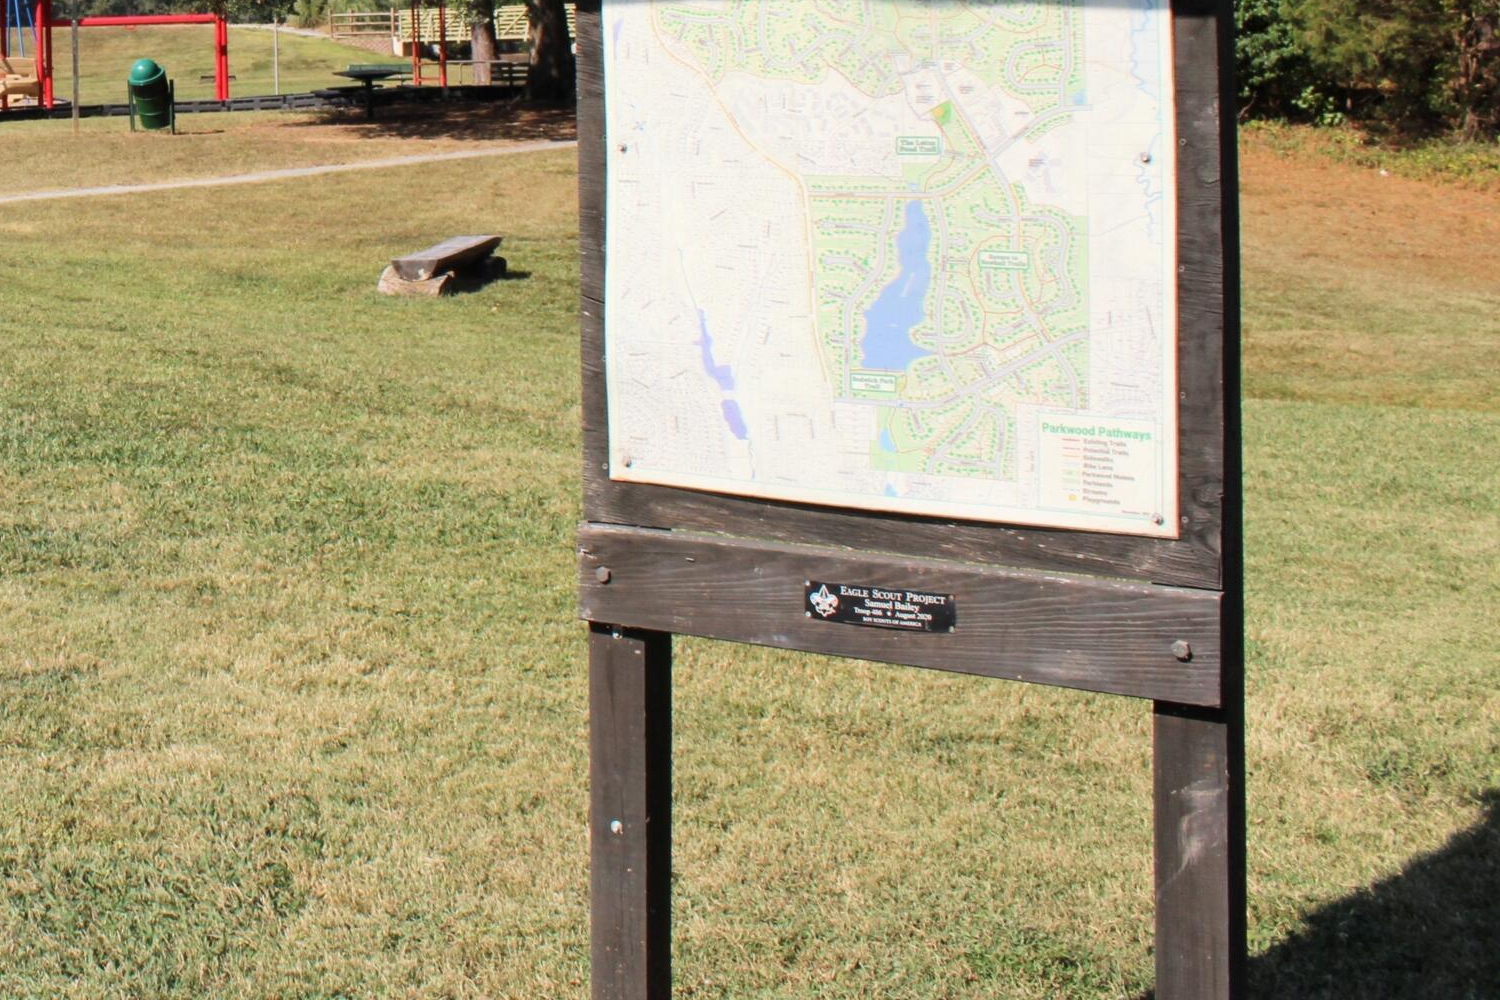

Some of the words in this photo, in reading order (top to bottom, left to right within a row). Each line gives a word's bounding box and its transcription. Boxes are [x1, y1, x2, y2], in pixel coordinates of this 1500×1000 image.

[1042, 422, 1095, 436] Parkwood
[1098, 426, 1152, 441] Pathways
[840, 586, 869, 598] EAGLE
[872, 589, 902, 601] SCOUT
[906, 592, 946, 605] PROJECT
[853, 607, 870, 615] Troop
[895, 612, 916, 620] August
[917, 613, 932, 621] 2020
[864, 599, 893, 609] Samuel
[895, 602, 920, 613] Bailey
